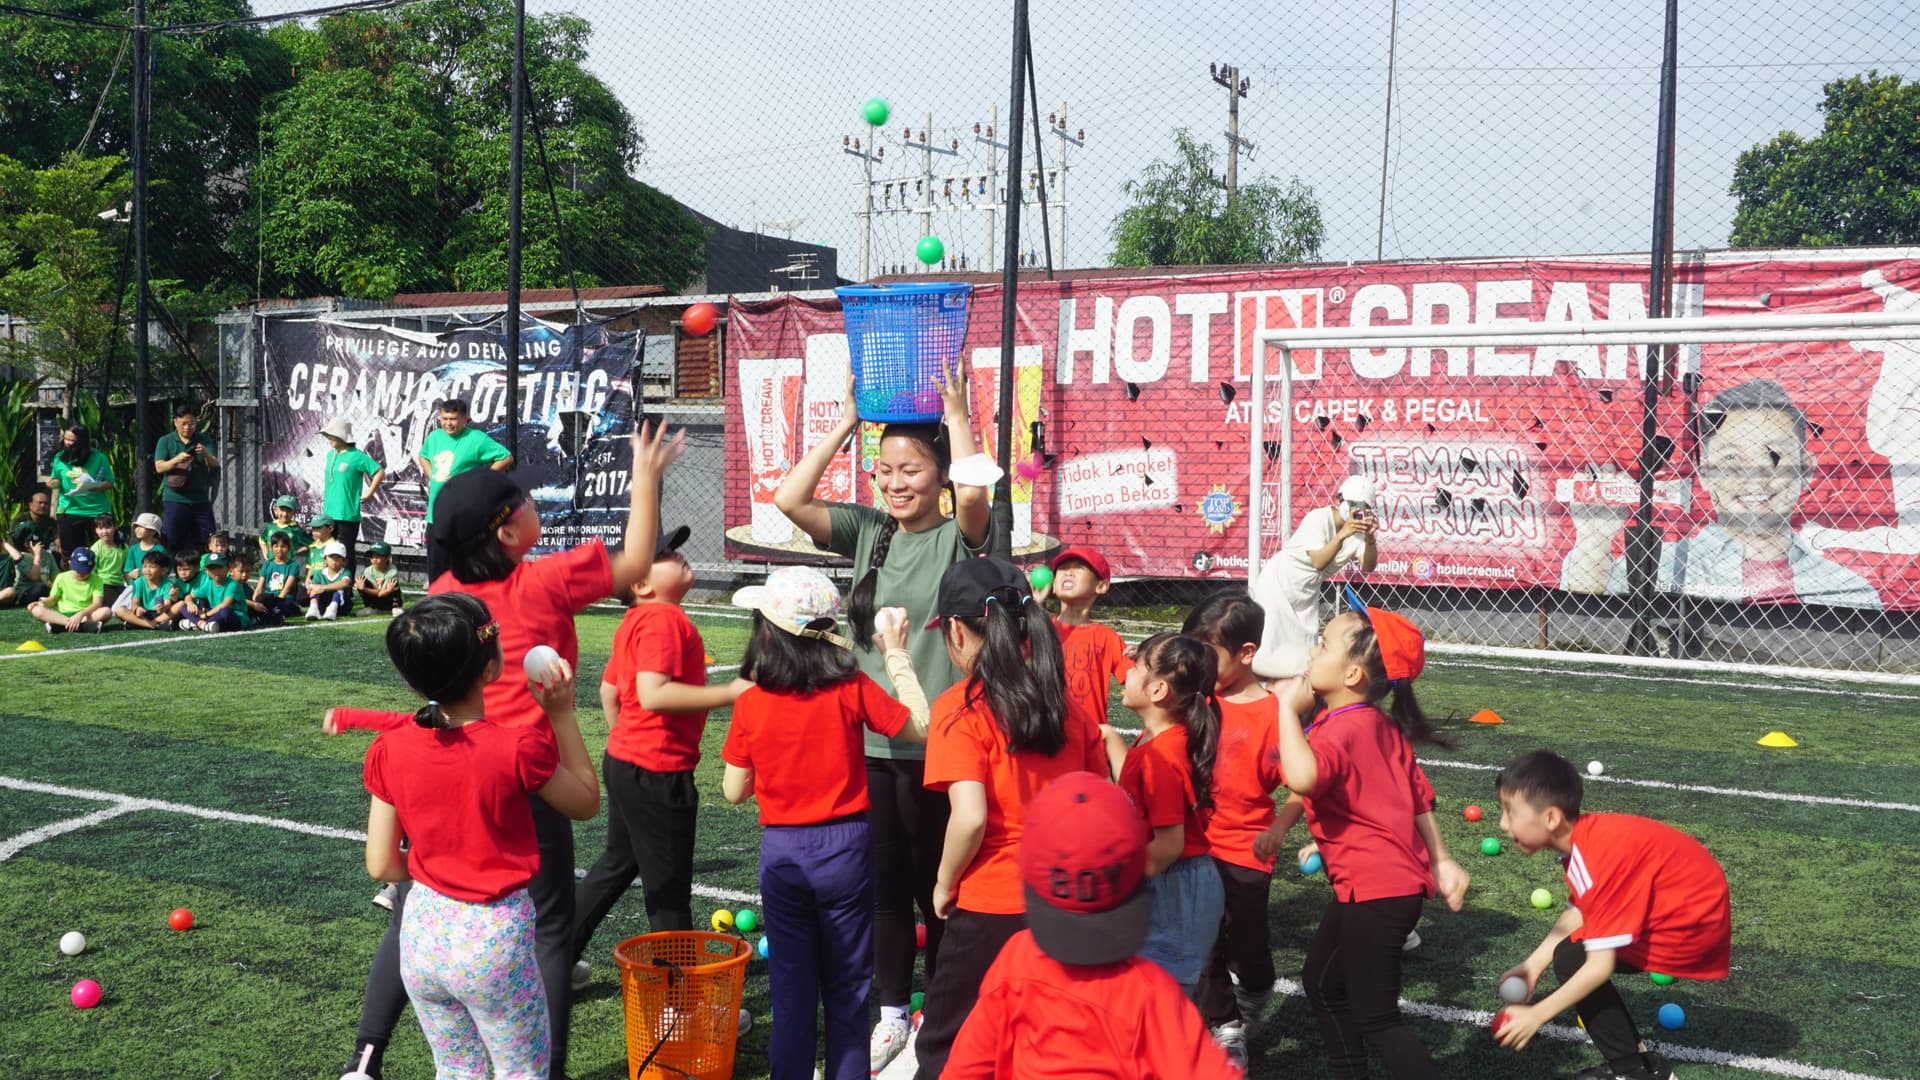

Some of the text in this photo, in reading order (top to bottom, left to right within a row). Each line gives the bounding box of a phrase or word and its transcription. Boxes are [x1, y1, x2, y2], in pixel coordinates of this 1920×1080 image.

[1349, 280, 1704, 382] CREAM
[326, 336, 562, 361] PRIVILEGE AUTO DETAING
[1294, 398, 1375, 424] CAPEK
[1381, 399, 1399, 423] &
[1405, 398, 1490, 424] PEGAL
[809, 419, 841, 434] CREA
[1060, 454, 1172, 485] Tidak Lengket
[1352, 446, 1529, 488] TEMAN
[584, 470, 628, 497] 2017
[1065, 483, 1171, 512] Tanpa Bekas
[1209, 498, 1229, 507] TOP
[541, 524, 622, 535] MORE INFORMATION
[550, 537, 573, 546] AUTO
[1436, 561, 1516, 578] hotincream.id
[1050, 862, 1122, 902] BOY
